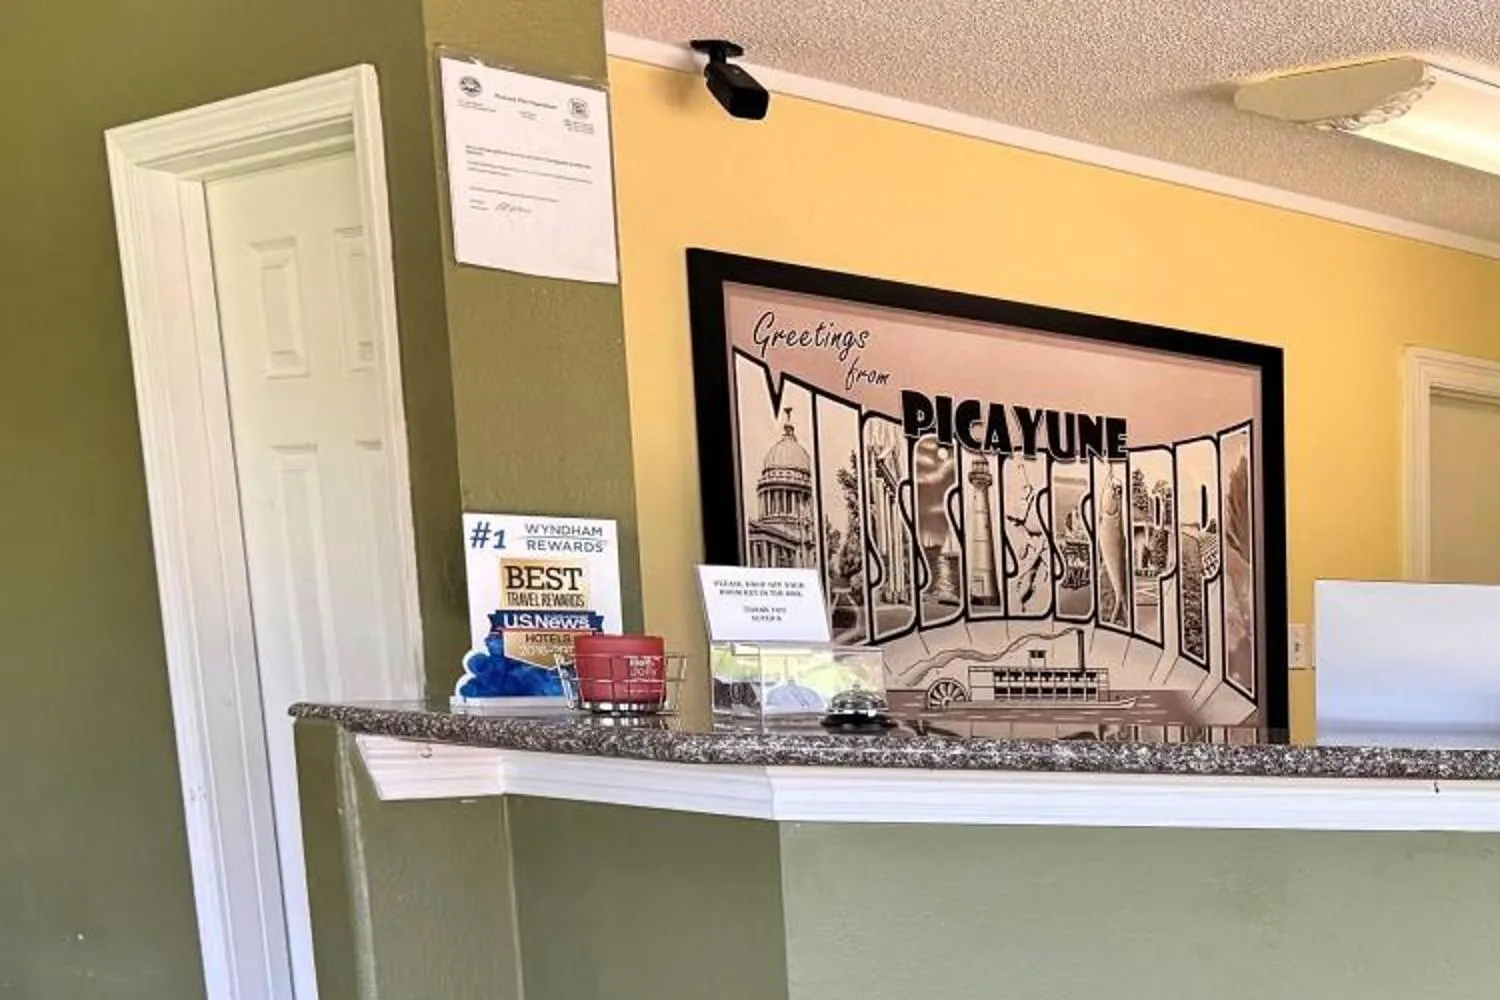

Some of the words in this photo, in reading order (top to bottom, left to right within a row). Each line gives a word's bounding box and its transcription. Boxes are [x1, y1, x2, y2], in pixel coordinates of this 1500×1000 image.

[752, 311, 870, 361] Greetings
[845, 356, 891, 390] from
[900, 389, 1128, 463] PICAYUNE
[469, 520, 508, 549] #1
[524, 523, 604, 537] WYNDHAM
[732, 345, 1258, 712] MISSISSIPPI
[526, 538, 605, 553] REWARDS
[502, 565, 584, 591] BEST
[507, 591, 541, 607] TRAVEL
[541, 592, 586, 608] REWARDS
[524, 633, 572, 644] HOTELS
